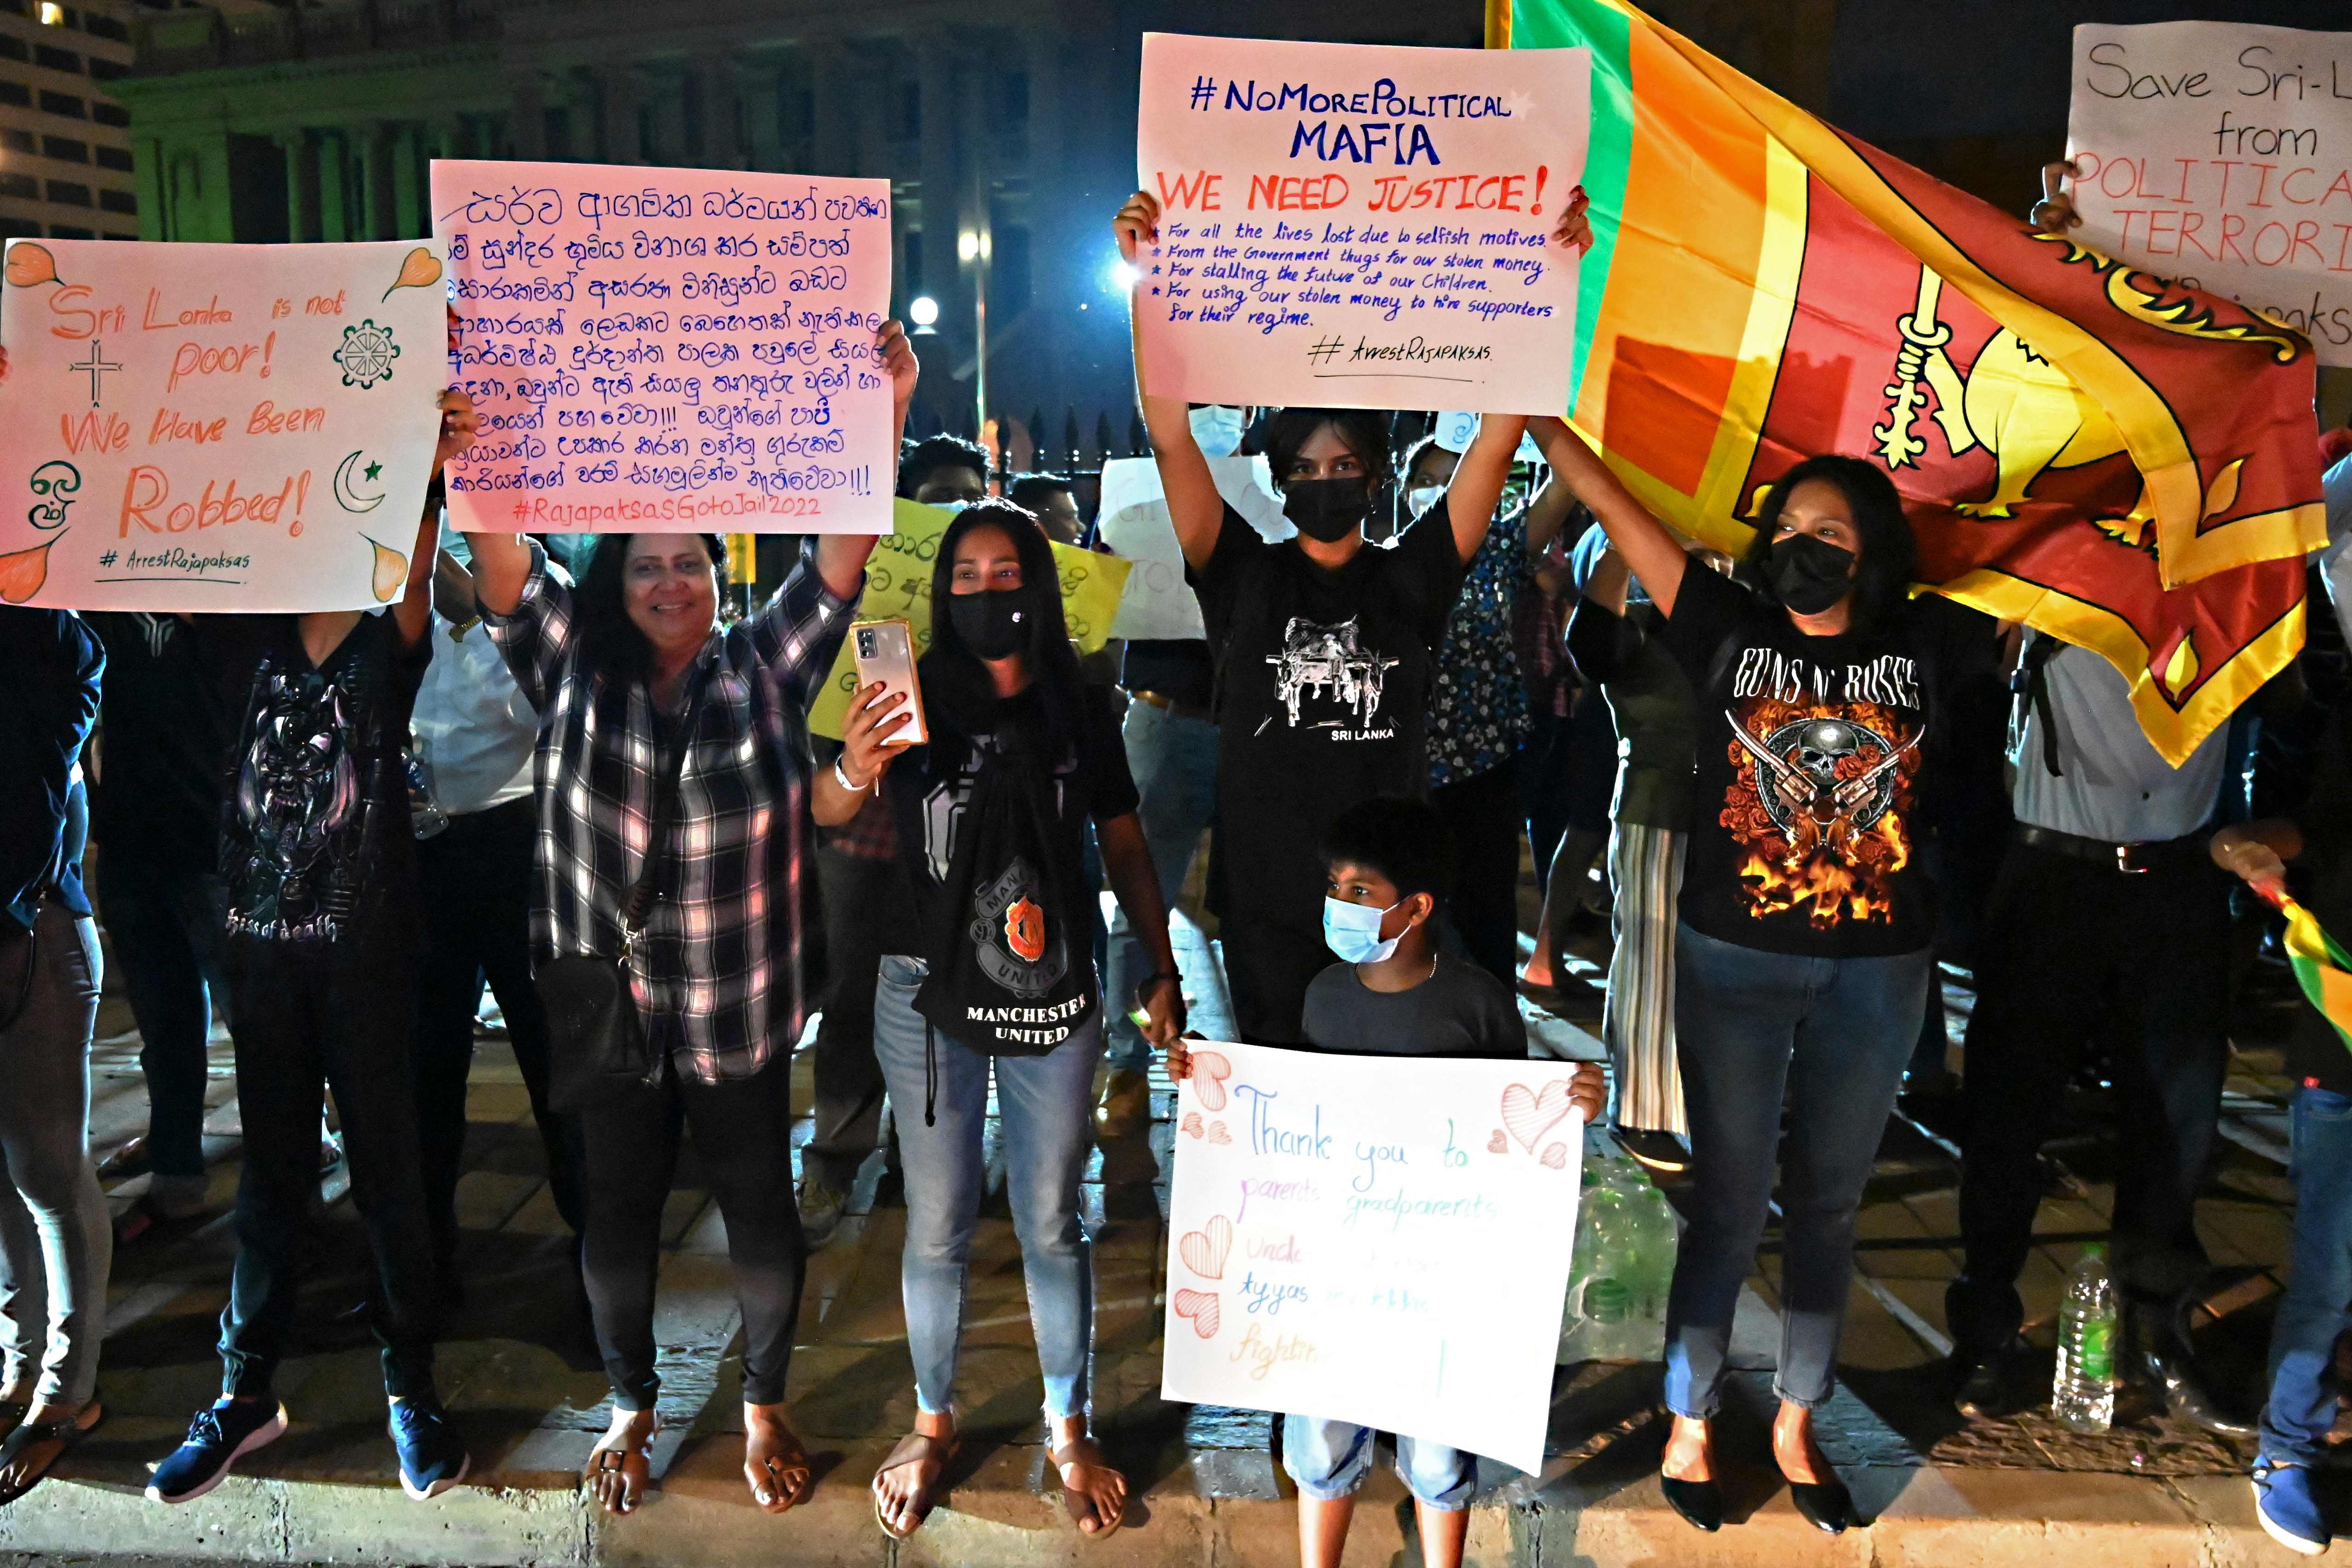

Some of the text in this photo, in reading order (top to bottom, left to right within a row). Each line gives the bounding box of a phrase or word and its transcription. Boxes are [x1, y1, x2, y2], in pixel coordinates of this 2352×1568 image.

[2087, 42, 2211, 99] Save
[1289, 120, 1440, 166] MAFIA
[2215, 111, 2317, 156] from
[440, 185, 562, 225] සර්ව
[704, 186, 818, 220] ධර්මයන්
[1157, 165, 1548, 216] WE NEED JUSTICE!
[481, 229, 555, 270] සුන්දර
[633, 231, 706, 258] විනාශ
[715, 233, 757, 257] කර
[767, 229, 850, 258] සම්පත්
[1168, 221, 1546, 248] For all the lives lost due to selfish motives.
[1166, 244, 1550, 286] From the Government thugs for our stolen money.
[1168, 261, 1194, 277] For
[1202, 262, 1270, 292] stalling
[1277, 264, 1298, 281] the
[1363, 271, 1382, 285] of
[1390, 277, 1415, 288] our
[1422, 273, 1492, 293] Children.
[683, 265, 776, 307] මිනිසුන්ට
[790, 266, 846, 291] බඩට
[1166, 282, 1553, 322] For using our stolen money to hire supporters
[49, 285, 126, 340] Sri
[271, 297, 291, 320] is
[306, 288, 345, 316] not
[580, 311, 668, 341] ලෙඩකට
[680, 300, 791, 332] බෙහෙතක්
[1168, 302, 1313, 334] for their regime.
[167, 331, 276, 394] poor!
[678, 342, 739, 367] පාලක
[753, 331, 819, 366] පවුලේ
[858, 373, 881, 390] හා
[61, 400, 326, 455] We Have Been
[558, 431, 624, 456] උපකාර
[118, 464, 312, 540] Robbed!
[1733, 647, 1803, 704] GUNS
[1844, 655, 1920, 710] ROSES
[1331, 729, 1394, 741] SRI LANKA
[967, 994, 1086, 1023] MANCHESTER
[995, 1026, 1069, 1045] UNITED
[1233, 1084, 1469, 1193] Thank you to
